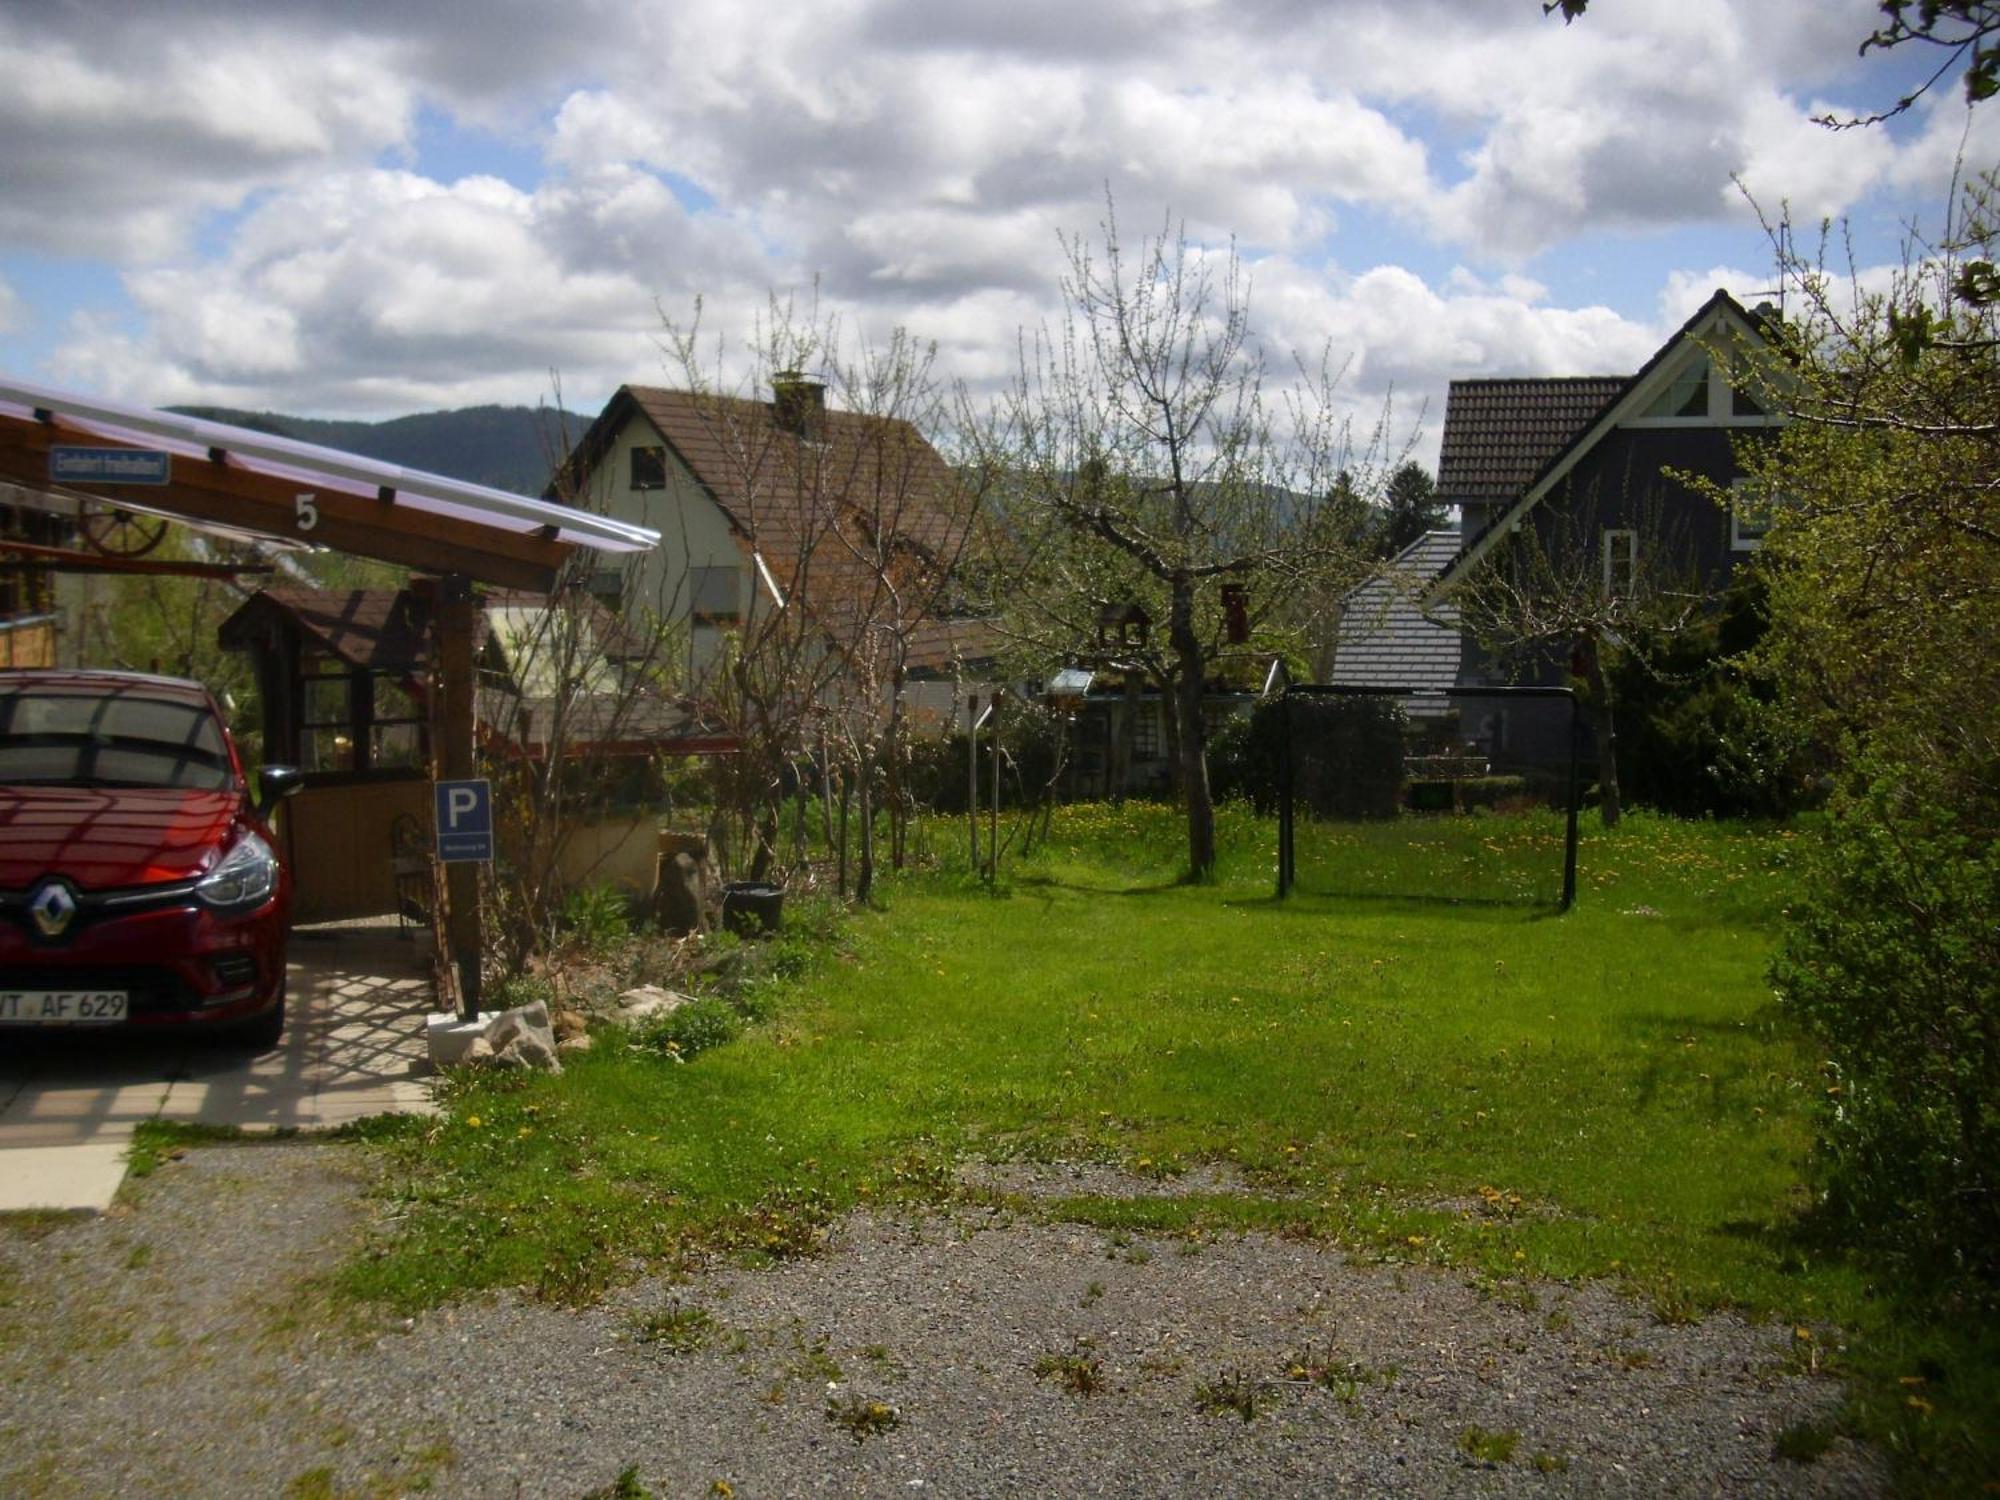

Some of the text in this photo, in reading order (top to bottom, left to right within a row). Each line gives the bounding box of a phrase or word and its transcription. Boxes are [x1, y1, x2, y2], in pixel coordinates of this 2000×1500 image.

[296, 494, 318, 530] 5
[449, 788, 477, 828] P
[0, 994, 125, 1017] T AF 629
